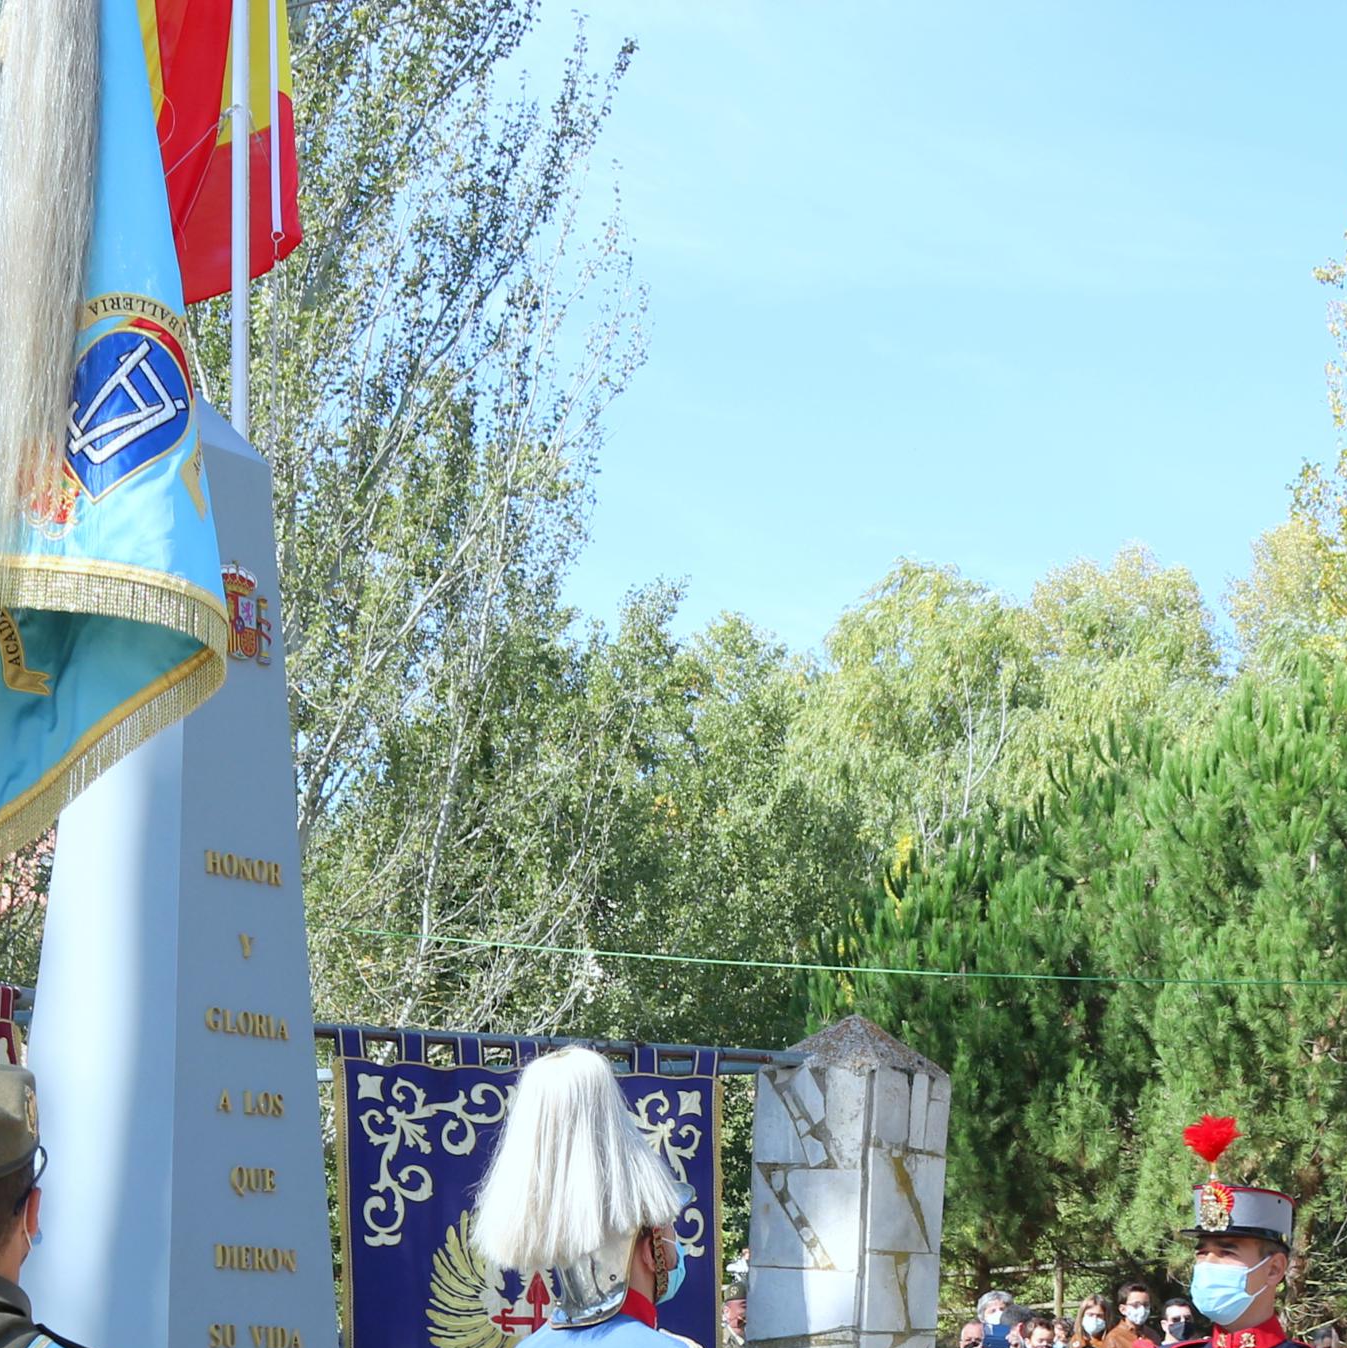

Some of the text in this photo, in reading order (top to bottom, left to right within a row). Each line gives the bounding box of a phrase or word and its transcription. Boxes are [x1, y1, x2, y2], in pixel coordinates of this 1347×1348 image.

[88, 296, 187, 339] ABALLERIA
[204, 849, 282, 887] HONOR
[238, 932, 254, 960] Y
[205, 1006, 289, 1041] GLORIA
[217, 1088, 284, 1118] A LOS
[229, 1164, 277, 1197] QUE
[214, 1243, 297, 1274] DIERON
